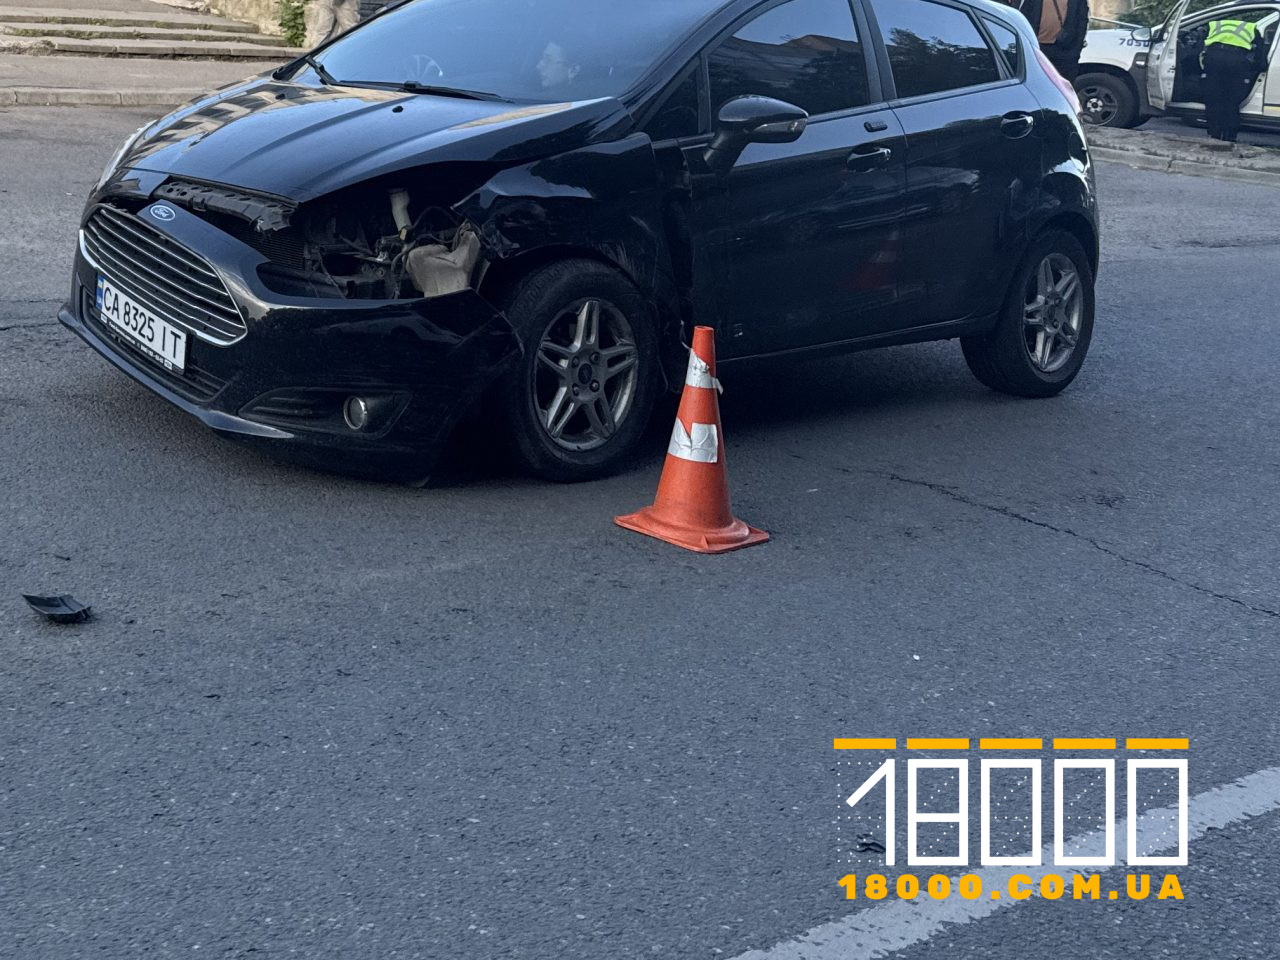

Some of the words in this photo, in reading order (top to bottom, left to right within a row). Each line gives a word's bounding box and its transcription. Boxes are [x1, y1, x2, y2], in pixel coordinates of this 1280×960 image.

[104, 286, 120, 320] CA
[123, 301, 155, 343] 8325
[162, 326, 182, 359] IT
